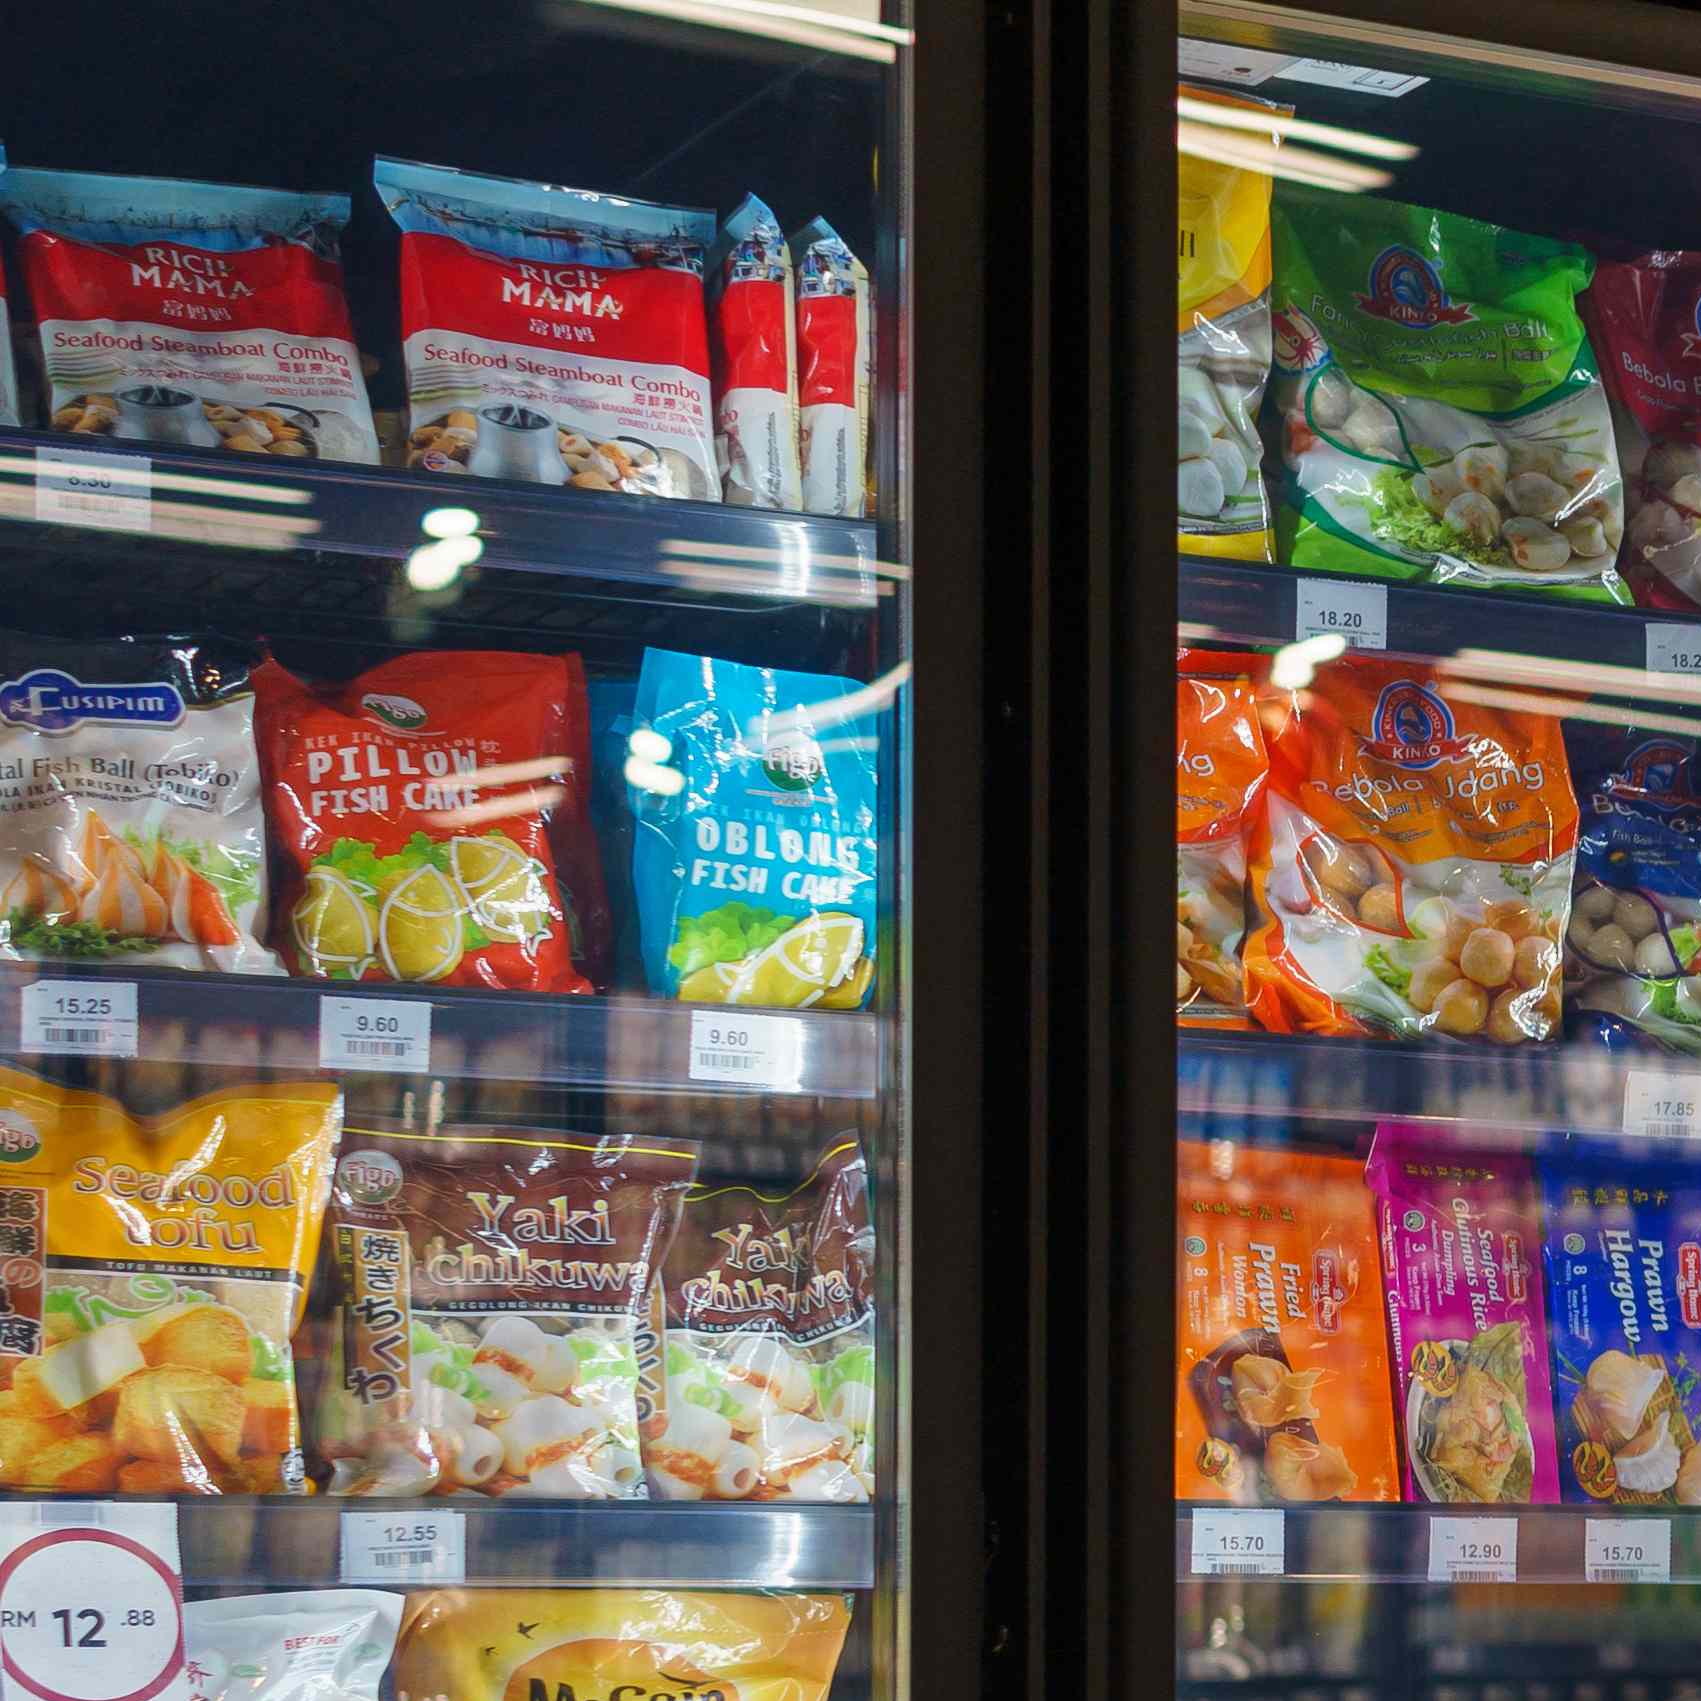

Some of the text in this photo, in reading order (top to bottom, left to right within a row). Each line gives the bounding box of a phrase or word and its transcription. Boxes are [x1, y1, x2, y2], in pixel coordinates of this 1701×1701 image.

[131, 262, 256, 300] MAMA
[144, 247, 234, 278] RICH
[518, 262, 608, 290] RICH
[501, 276, 625, 322] MAMA
[53, 331, 350, 368] Seafood Steamboat Combo
[423, 343, 702, 403] Seafood Steamboat Combo
[1620, 351, 1687, 393] Bebola
[1318, 610, 1363, 629] 18.20
[31, 756, 82, 781] Fish
[89, 756, 137, 782] Ball
[74, 777, 143, 794] KRISTAL
[307, 746, 479, 785] PILLOW
[311, 782, 481, 817] FISH CAKE
[694, 816, 861, 871] OBLONG
[691, 858, 858, 906] FISH CAKE
[54, 997, 113, 1016] 15.25
[356, 1015, 400, 1034] 9.60
[709, 1027, 750, 1049] 9.60
[1653, 1101, 1695, 1117] 17.85
[71, 1155, 298, 1210] Seafood
[343, 1160, 396, 1190] Figo
[124, 1207, 266, 1256] tofu
[466, 1191, 617, 1247] Yaki
[427, 1242, 650, 1293] chikuwa
[1440, 1229, 1456, 1297] Dumpling
[1451, 1197, 1488, 1332] Glutinous Rice
[1477, 1228, 1505, 1303] Seafood
[1231, 1255, 1248, 1319] Wonton
[1248, 1241, 1281, 1334] Prawn
[1279, 1262, 1307, 1320] Fried
[1604, 1228, 1642, 1345] Hargow
[1638, 1238, 1670, 1333] Prawn
[348, 1232, 408, 1406] 焼きちくわ
[382, 1524, 439, 1544] 12.55
[1219, 1534, 1265, 1554] 15.70
[1459, 1542, 1502, 1561] 12.90
[1601, 1544, 1644, 1562] 15.70
[52, 1608, 156, 1648] 12 .88
